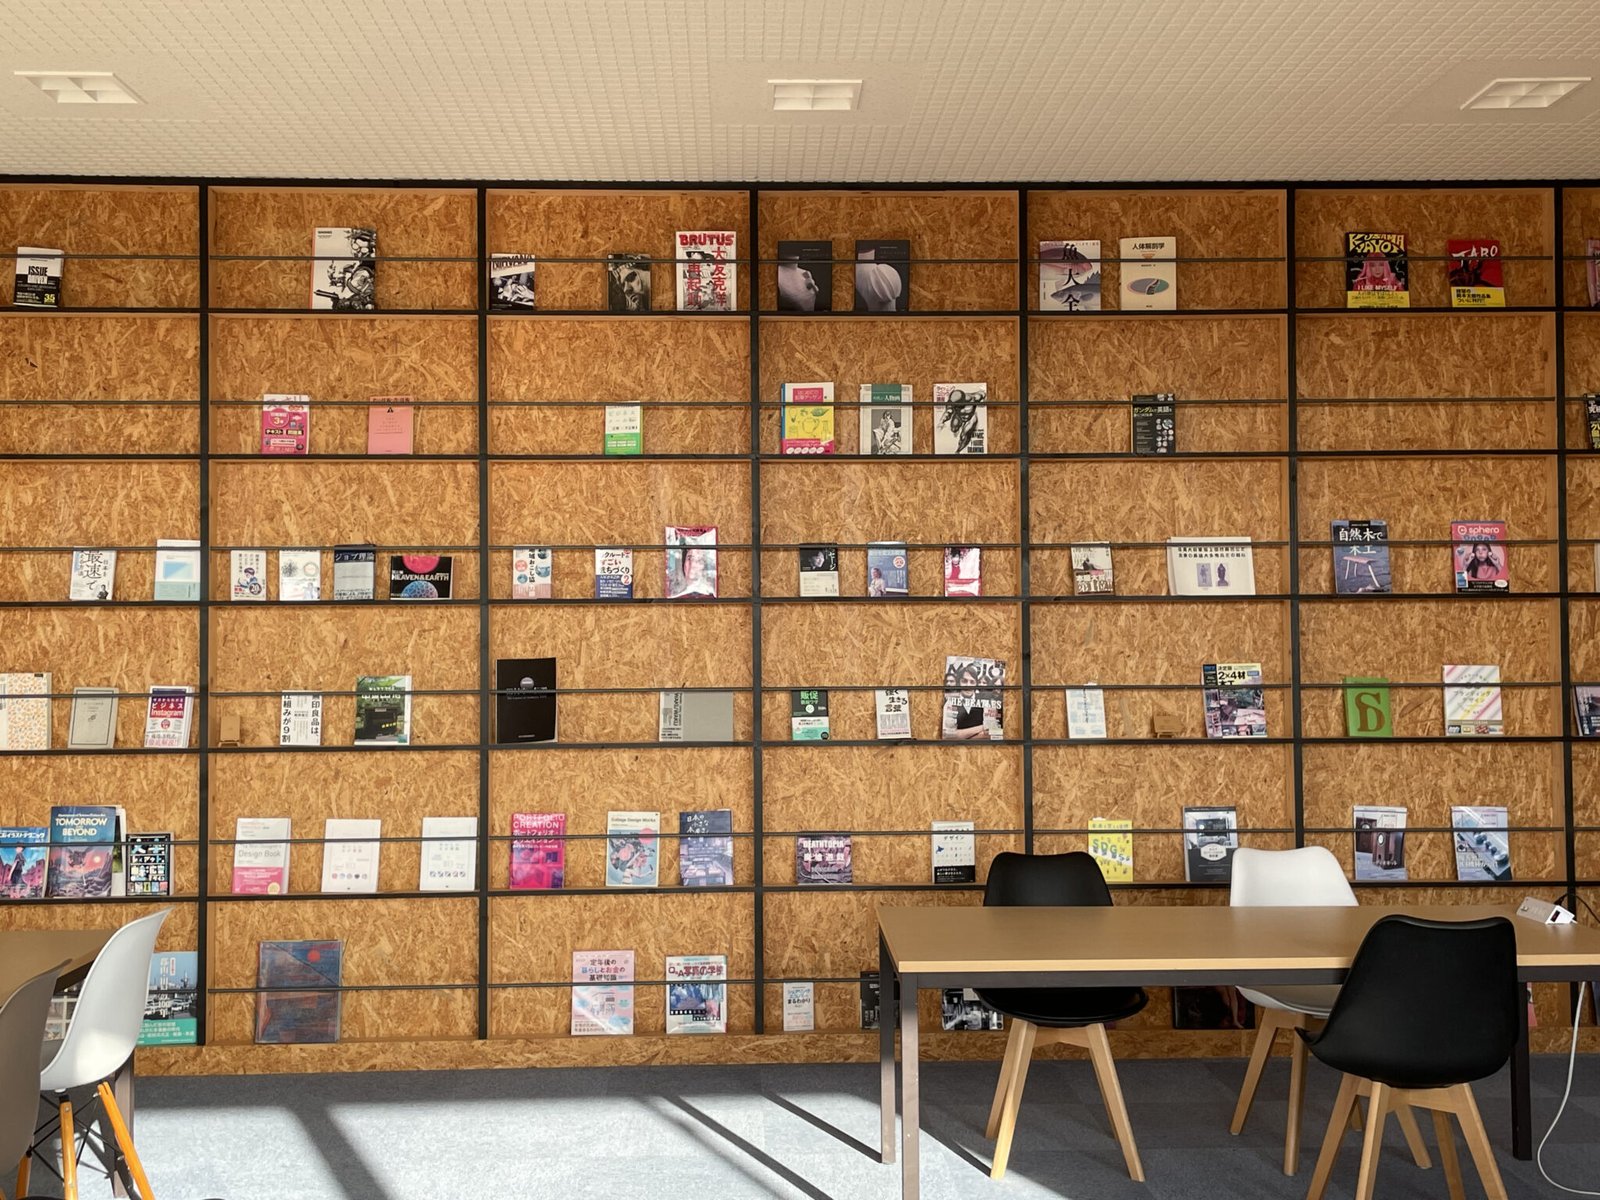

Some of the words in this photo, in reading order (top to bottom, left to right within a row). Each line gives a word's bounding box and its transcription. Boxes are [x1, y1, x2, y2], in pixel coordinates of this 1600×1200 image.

[679, 233, 735, 247] BRUTUS
[1349, 233, 1405, 252] KUSAMA
[1354, 239, 1404, 253] YAYOI
[1451, 245, 1499, 267] TARO
[28, 265, 48, 277] ISSUE
[713, 246, 728, 307] 大友克洋
[44, 293, 55, 302] 35
[1339, 527, 1384, 541] 自然木で
[1469, 526, 1500, 536] sphero
[1349, 545, 1377, 555] 木工
[335, 552, 375, 561] ジョブ理論
[391, 572, 449, 581] HEAVEN&EARTH
[624, 575, 630, 584] 2
[948, 663, 1003, 680] MOJO
[948, 697, 963, 706] THE
[965, 699, 1002, 709] BEATLES
[151, 709, 184, 717] Instagram
[56, 818, 108, 826] TOMORROW
[513, 821, 559, 829] CREATION
[62, 828, 97, 836] BEYOND
[803, 840, 845, 848] DEATHTOPIA
[238, 850, 263, 859] Design
